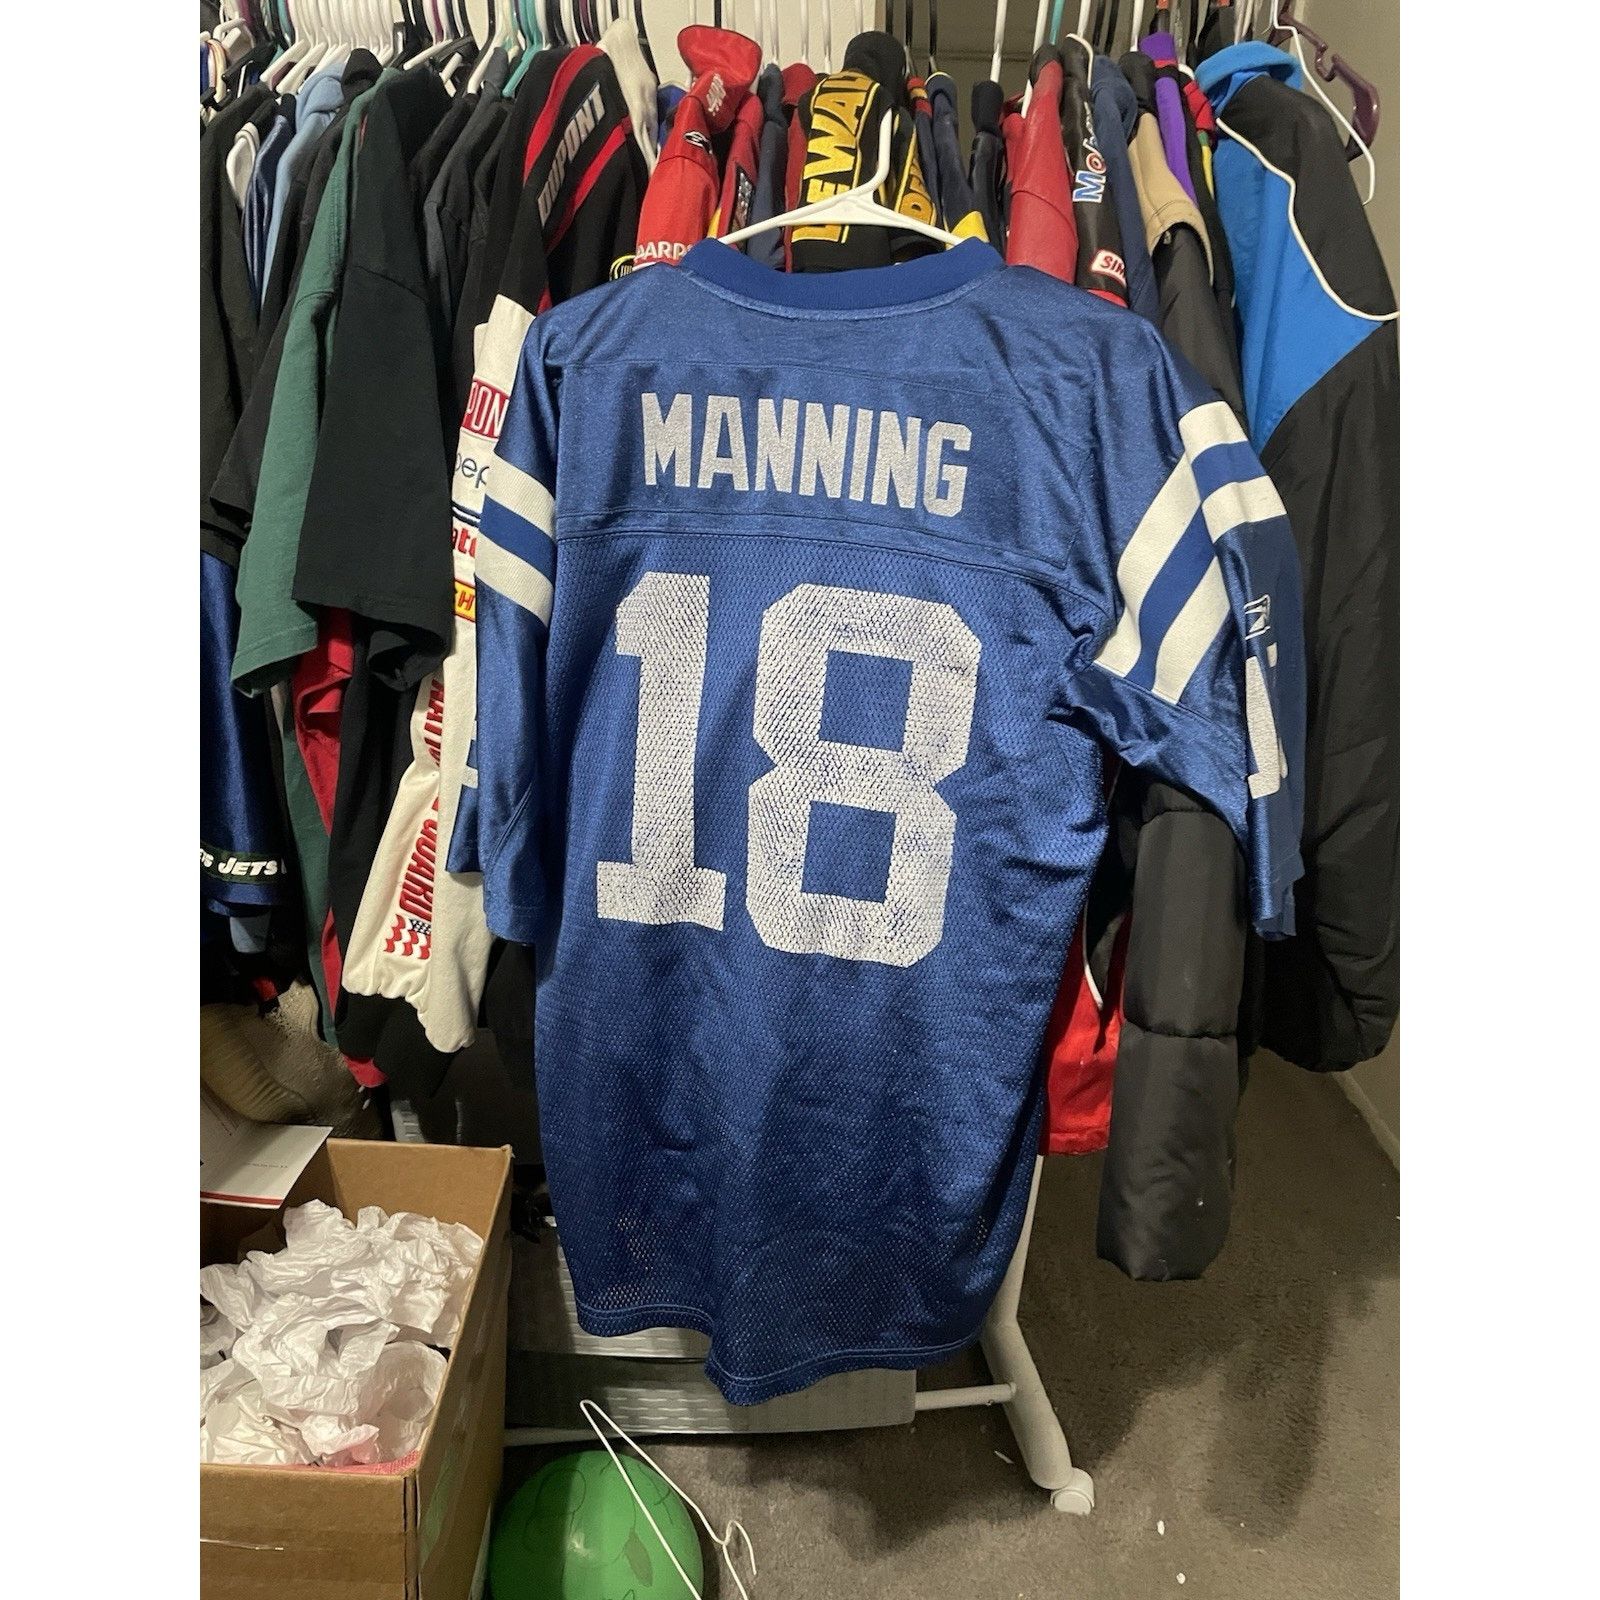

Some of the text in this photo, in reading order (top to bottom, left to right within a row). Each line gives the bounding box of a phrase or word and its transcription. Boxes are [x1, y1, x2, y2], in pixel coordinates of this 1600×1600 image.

[641, 393, 972, 517] MANNING
[597, 571, 981, 967] 18
[218, 857, 278, 876] JETS
